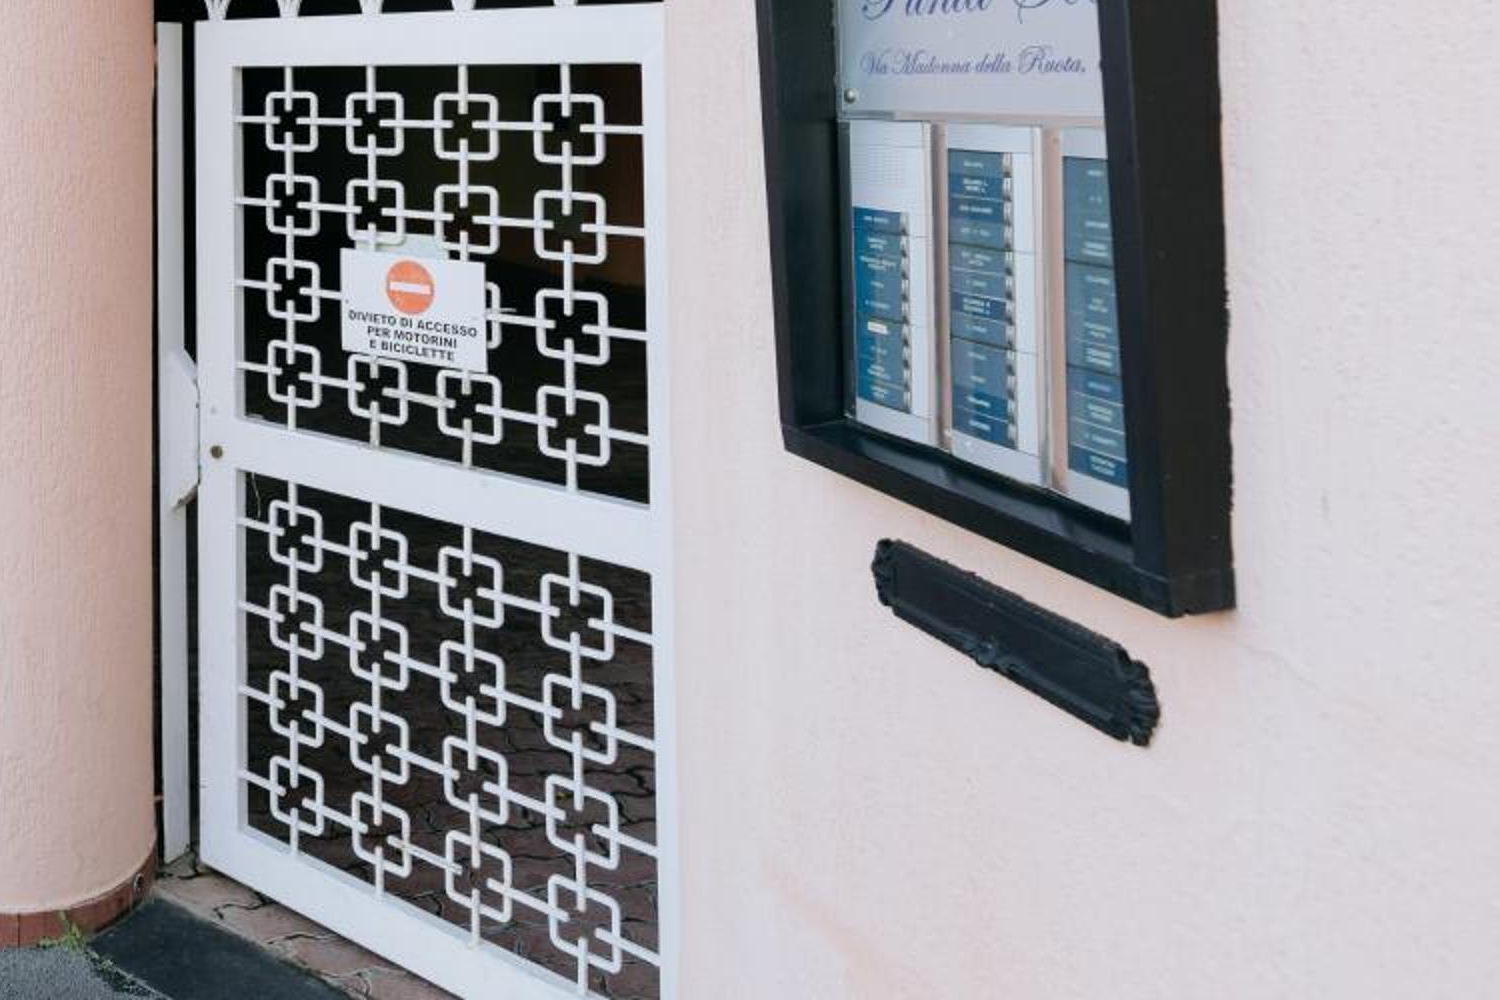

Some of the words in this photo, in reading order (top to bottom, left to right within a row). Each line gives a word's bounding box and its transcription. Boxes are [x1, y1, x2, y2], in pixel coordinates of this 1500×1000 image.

[860, 50, 888, 75] Via
[891, 50, 971, 75] Madonna
[975, 53, 1011, 73] della
[348, 309, 396, 326] DIVIETO
[400, 317, 413, 328] DI
[417, 319, 478, 337] ACCESSO
[367, 325, 390, 337] PER
[393, 329, 457, 348] MOTORINI
[369, 338, 377, 349] E
[381, 341, 455, 361] BICICLETTE
